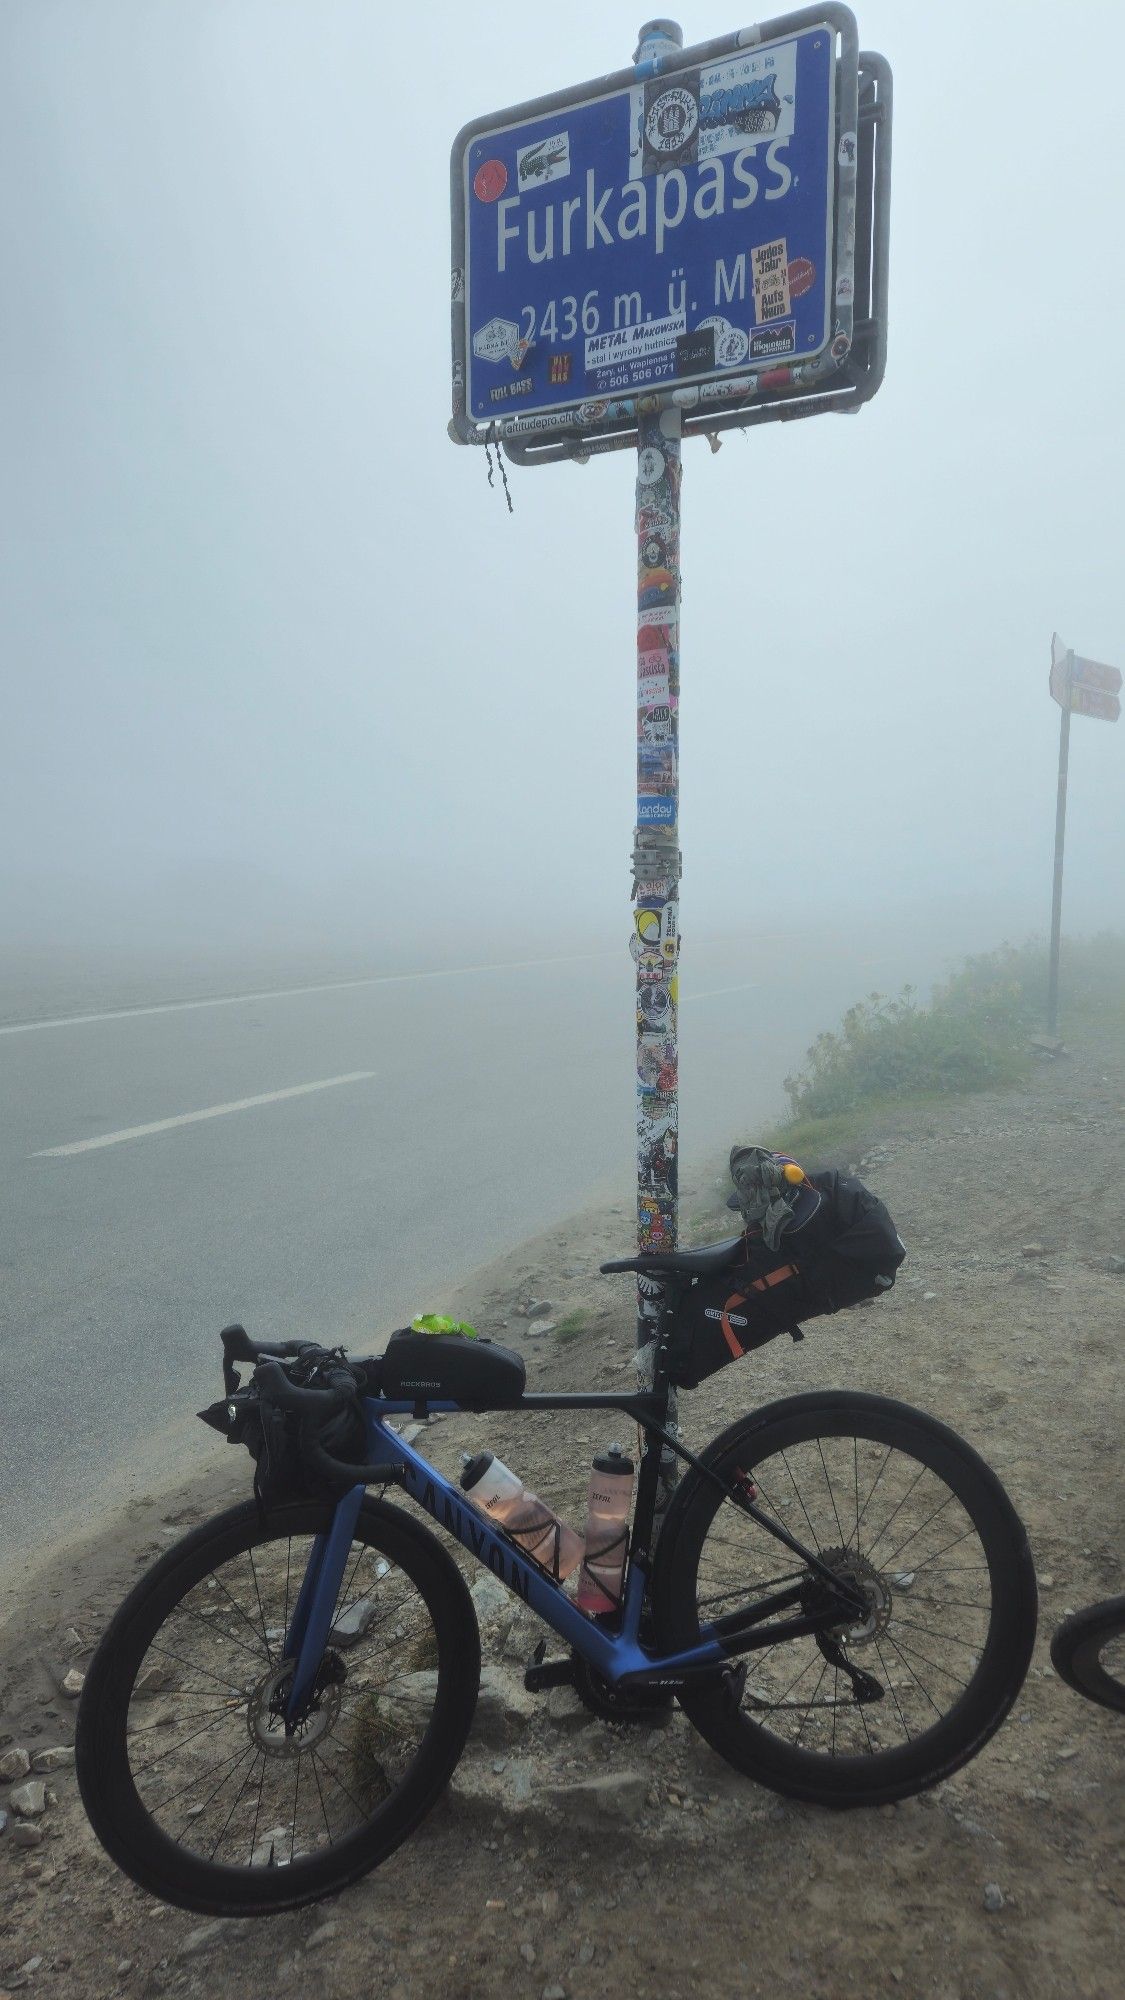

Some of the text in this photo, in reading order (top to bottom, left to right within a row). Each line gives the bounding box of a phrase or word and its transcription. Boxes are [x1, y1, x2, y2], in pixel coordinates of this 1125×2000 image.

[497, 136, 791, 272] Furkapass
[759, 257, 781, 275] Jahr
[521, 290, 599, 347] 2436
[614, 290, 652, 329] m.
[668, 267, 697, 315] ü.
[588, 331, 627, 352] METAL
[591, 353, 606, 365] stal
[612, 345, 643, 360] wyroby
[644, 337, 676, 351] hutnicz
[609, 362, 674, 387] 506 506 071
[617, 364, 627, 372] ul.
[629, 354, 668, 371] Wapienna
[506, 410, 574, 434] altitudepro.ch
